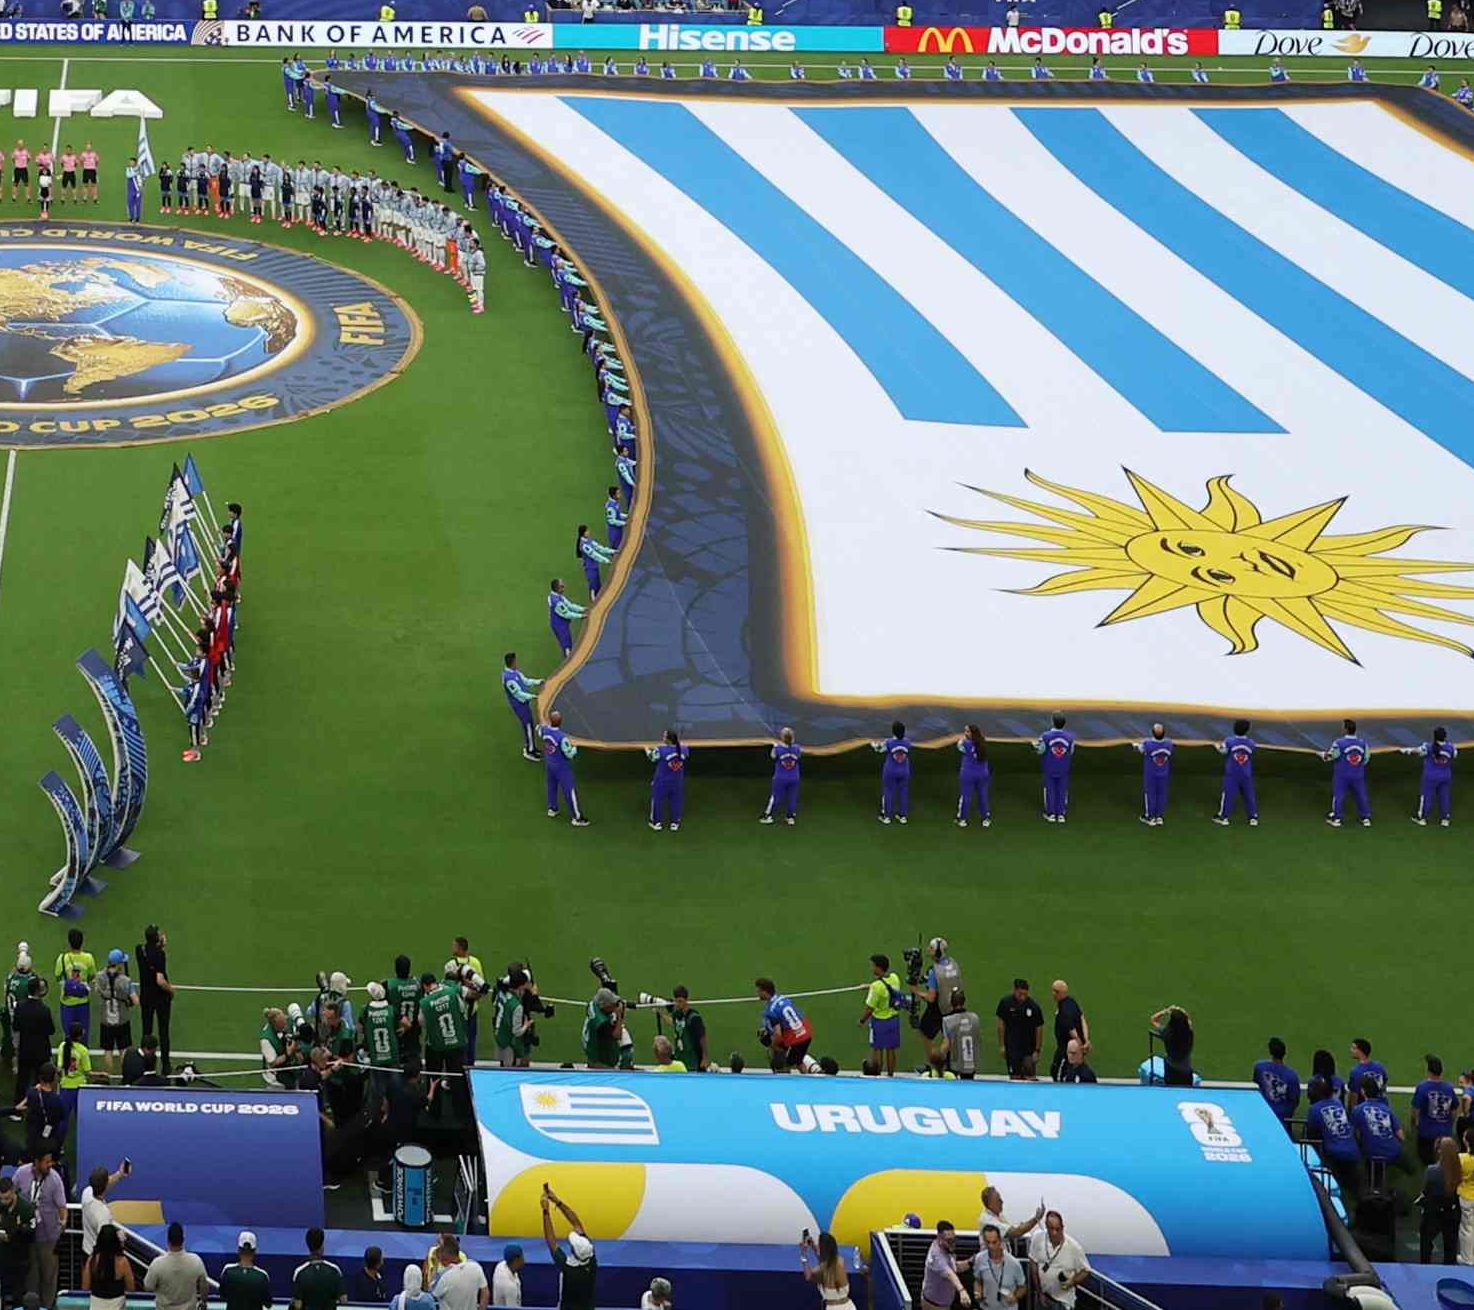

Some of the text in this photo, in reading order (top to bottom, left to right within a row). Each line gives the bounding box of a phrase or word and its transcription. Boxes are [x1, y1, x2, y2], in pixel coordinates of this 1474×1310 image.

[15, 22, 78, 42] STATES
[81, 22, 105, 42] OF
[236, 25, 507, 45] BANK OF AMERICA
[637, 24, 796, 51] Hisense
[987, 27, 1188, 54] McDonald's
[1253, 31, 1323, 56] Dove
[40, 229, 178, 249] WORLD
[184, 239, 260, 264] FIFA
[340, 301, 386, 347] FIFA
[29, 417, 122, 434] CUP
[129, 392, 282, 428] 2026
[96, 1101, 300, 1116] FIFA WORLD CUP 2026
[770, 1102, 1061, 1139] URUGUAY
